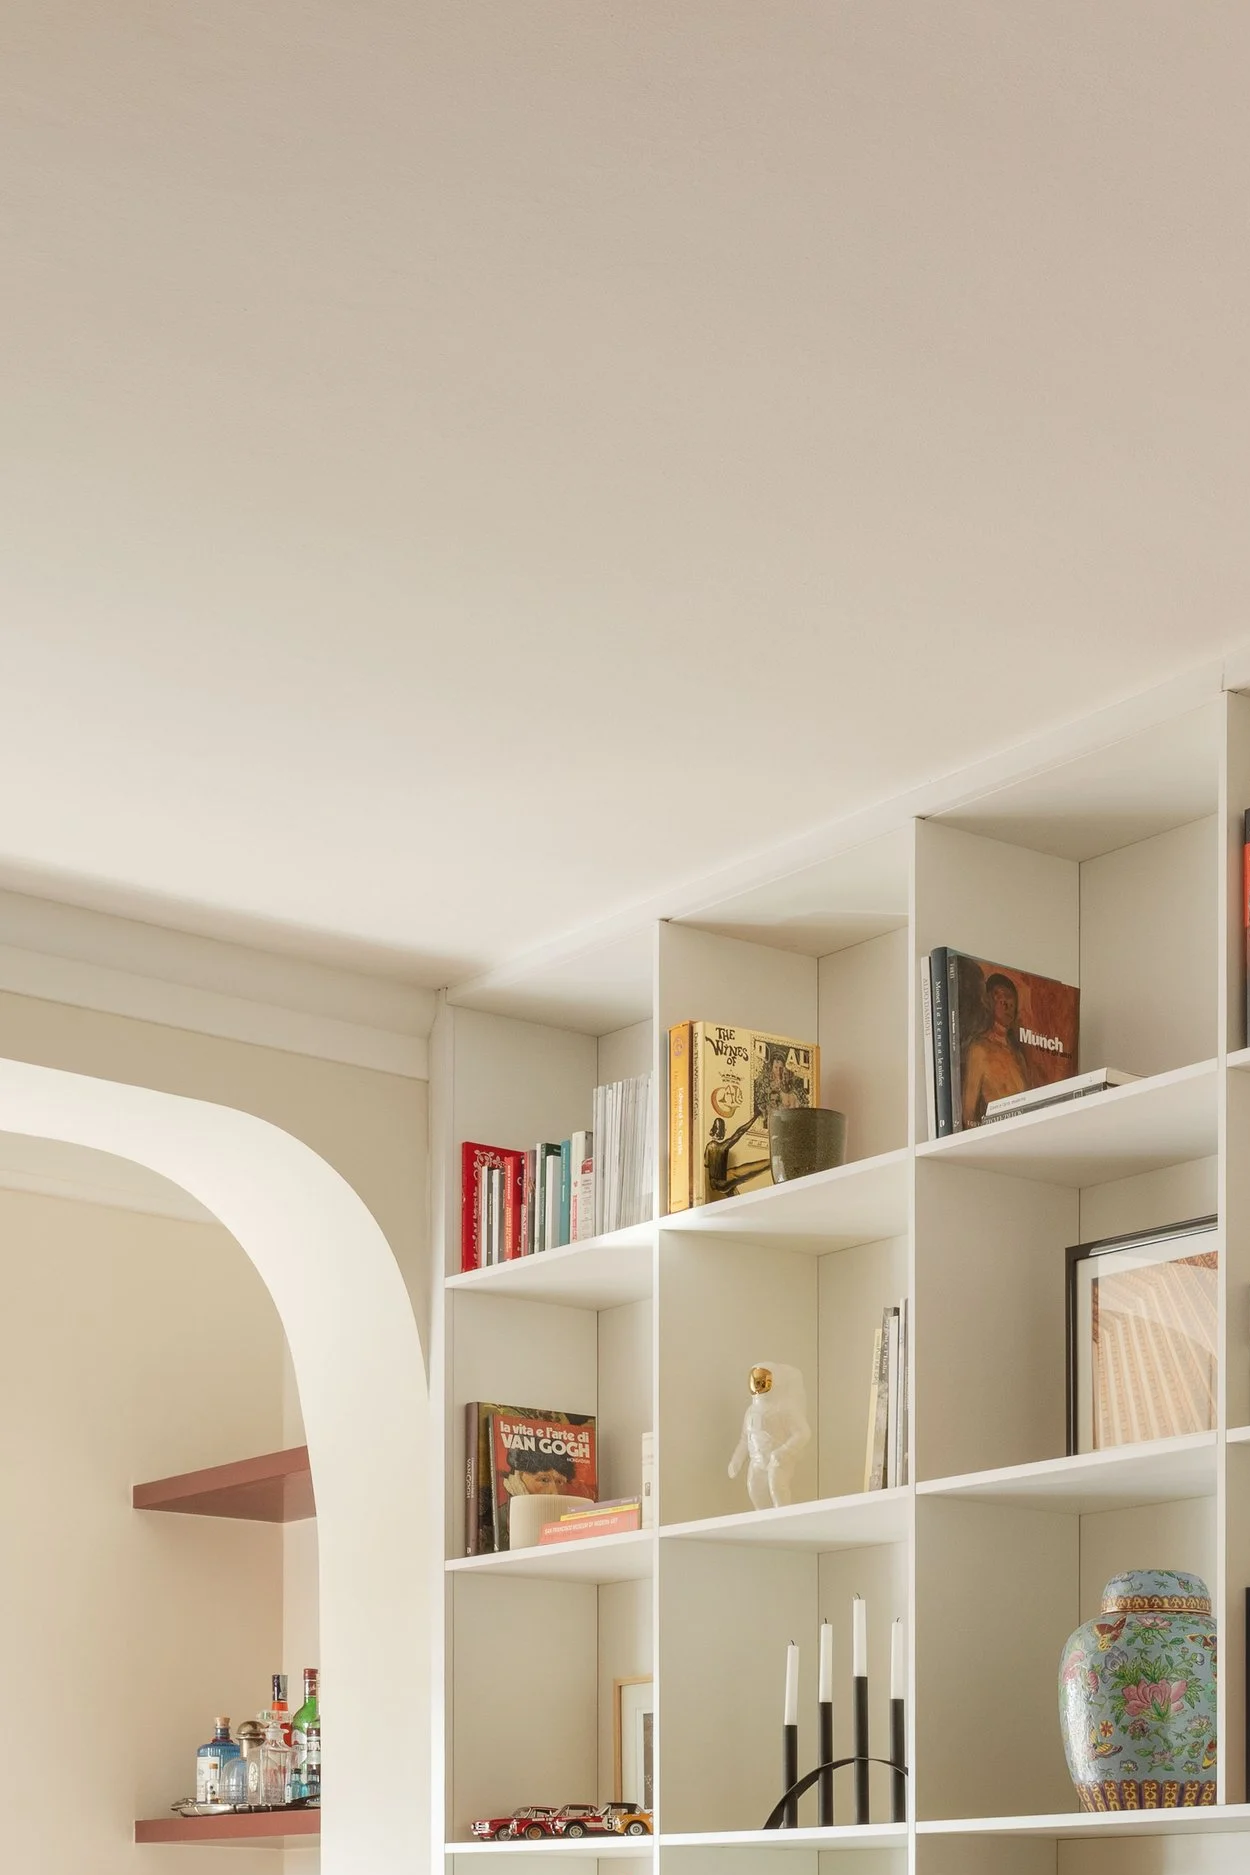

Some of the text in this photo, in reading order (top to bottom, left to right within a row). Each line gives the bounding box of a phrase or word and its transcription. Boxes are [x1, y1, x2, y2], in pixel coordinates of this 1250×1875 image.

[716, 1027, 735, 1040] THE
[1020, 1027, 1064, 1052] Munch
[726, 1057, 737, 1066] OF
[500, 1420, 588, 1443] la vita e l'arte di
[500, 1433, 590, 1458] VAN GOGH
[607, 1818, 613, 1830] 5
